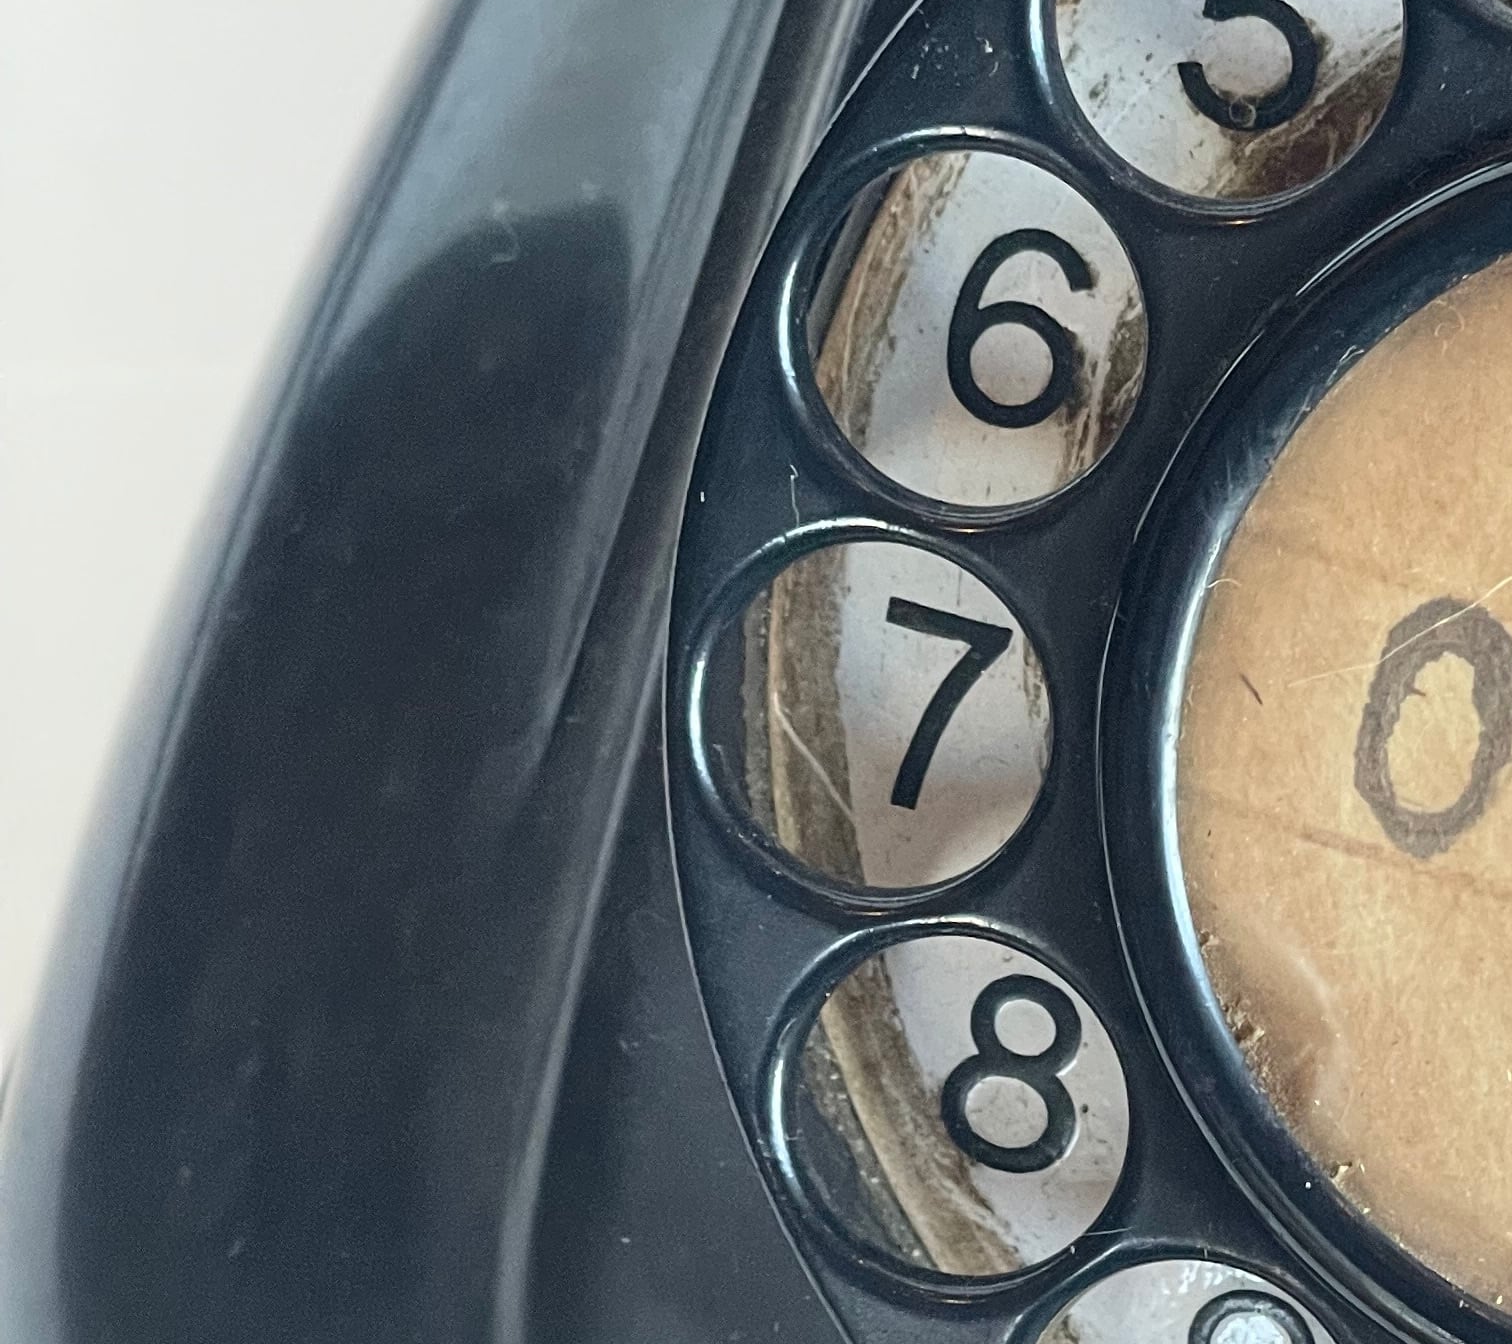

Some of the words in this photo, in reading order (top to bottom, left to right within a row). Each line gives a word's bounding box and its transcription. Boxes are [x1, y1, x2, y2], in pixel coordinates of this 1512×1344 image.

[947, 227, 1093, 429] 6
[886, 596, 1013, 810] 7
[941, 974, 1081, 1173] 8
